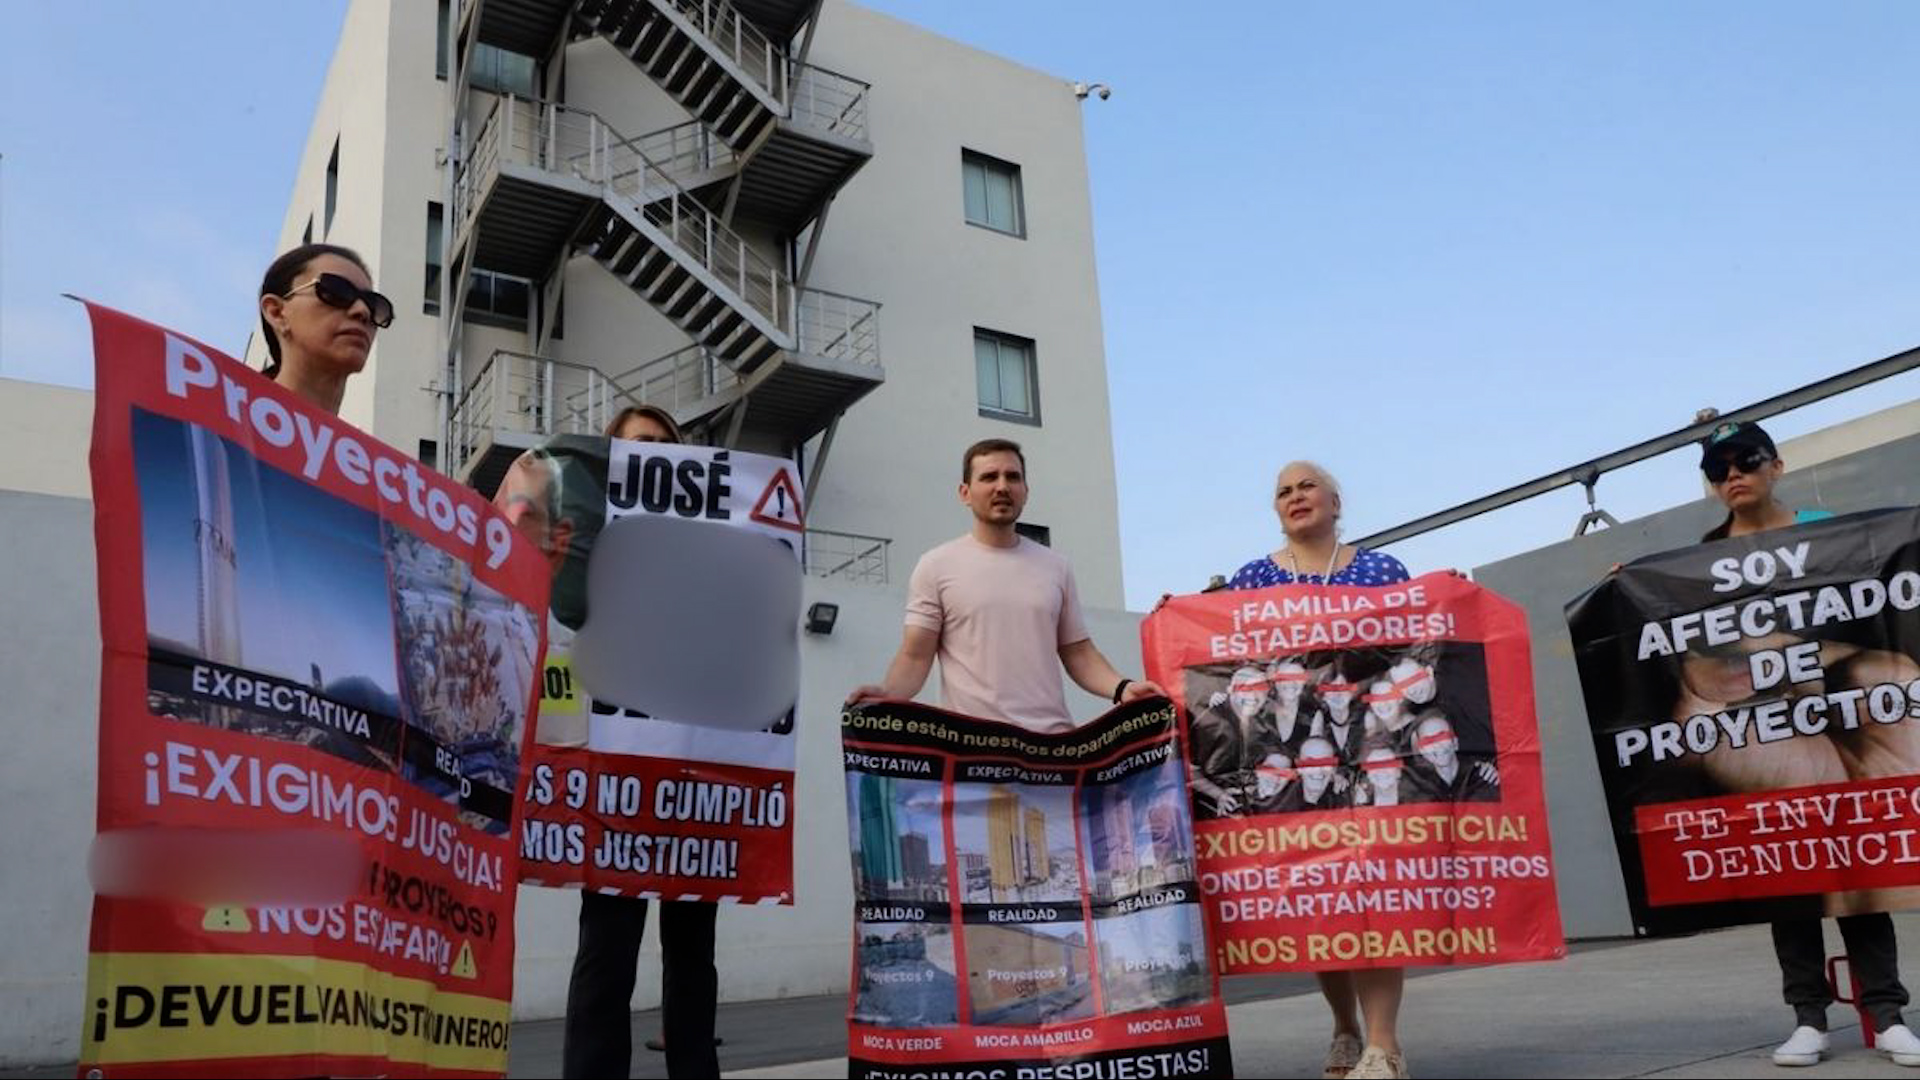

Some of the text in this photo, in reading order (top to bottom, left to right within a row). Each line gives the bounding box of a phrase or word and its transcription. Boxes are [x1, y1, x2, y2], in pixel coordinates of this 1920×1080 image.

[163, 332, 512, 569] Proyectos 9
[608, 451, 731, 519] JOSÉ
[1710, 541, 1811, 593] SOY
[1232, 585, 1428, 631] ¡FAMILIA DE
[1637, 571, 1920, 661] AFECTADO
[1210, 613, 1456, 658] ESTAFADORES!
[541, 666, 573, 700] O!
[1750, 641, 1824, 691] DE
[192, 664, 371, 739] EXPECTATIVA
[906, 719, 959, 743] están
[963, 733, 1049, 756] nuestros
[967, 765, 1063, 783] EXPECTATIVA
[1097, 744, 1173, 781] EXPECTATIVA
[144, 741, 399, 842] ¡EXIGIMOS
[526, 764, 786, 828] S 9 NO CUMPLIÓ
[1664, 808, 1730, 842] TE
[594, 830, 739, 878] JUSTICIA!
[1290, 859, 1387, 888] ESTAN
[1395, 855, 1550, 881] NUESTROS
[861, 907, 925, 921] REALIDAD
[988, 908, 1058, 922] REALIDAD
[1117, 889, 1186, 914] REALIDAD
[1219, 886, 1496, 922] DEPARTAMENTOS?
[1217, 926, 1498, 974] ¡NOS ROBARON!
[93, 985, 369, 1042] ¡DEVUELVAN
[1127, 1015, 1204, 1035] MOCA AZUL
[863, 1036, 943, 1051] MOCA VERDE
[975, 1028, 1093, 1047] MOCA AMARILLO
